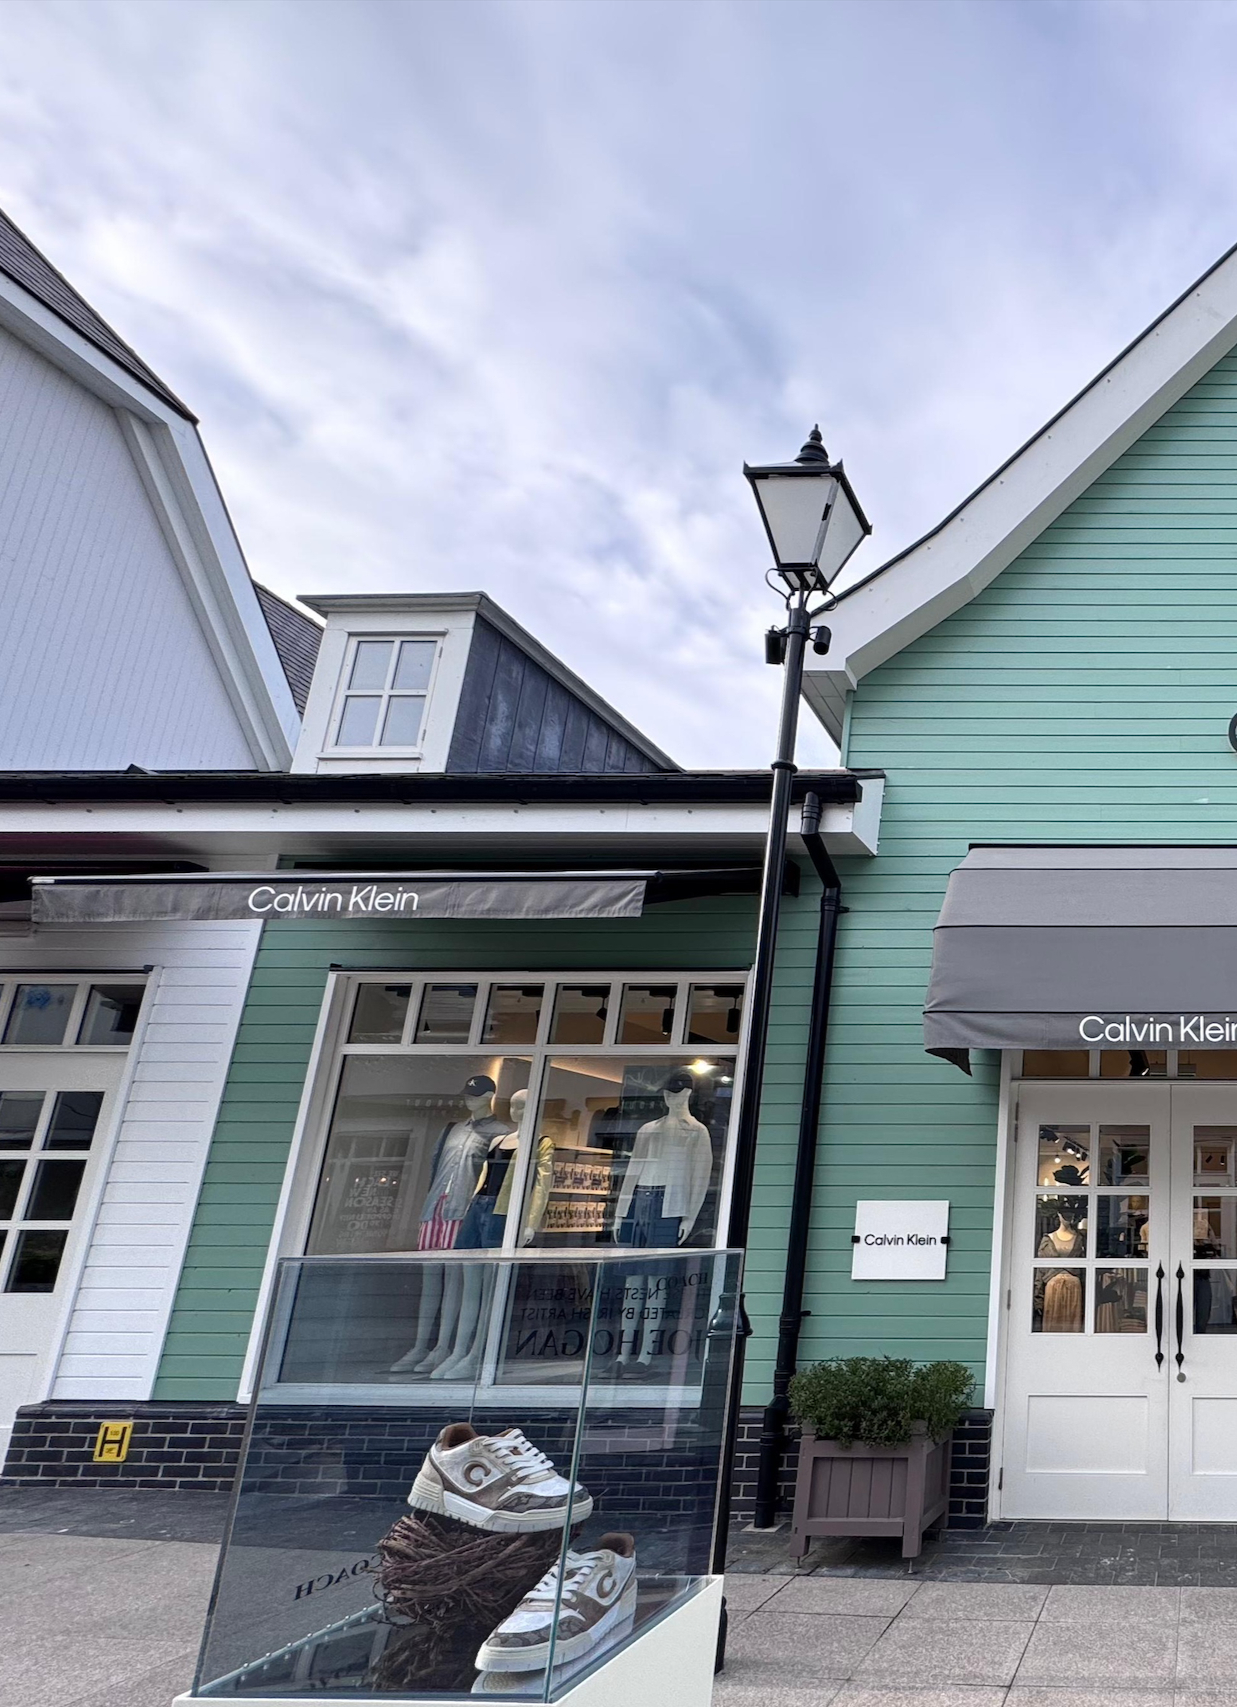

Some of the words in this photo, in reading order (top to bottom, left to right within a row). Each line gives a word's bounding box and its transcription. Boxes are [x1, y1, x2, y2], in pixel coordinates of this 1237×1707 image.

[248, 885, 343, 912] Calvin
[348, 885, 419, 911] Klein
[1079, 1015, 1173, 1042] Calvin
[864, 1233, 904, 1246] Calvin
[907, 1233, 937, 1246] Klein
[98, 1426, 128, 1458] H
